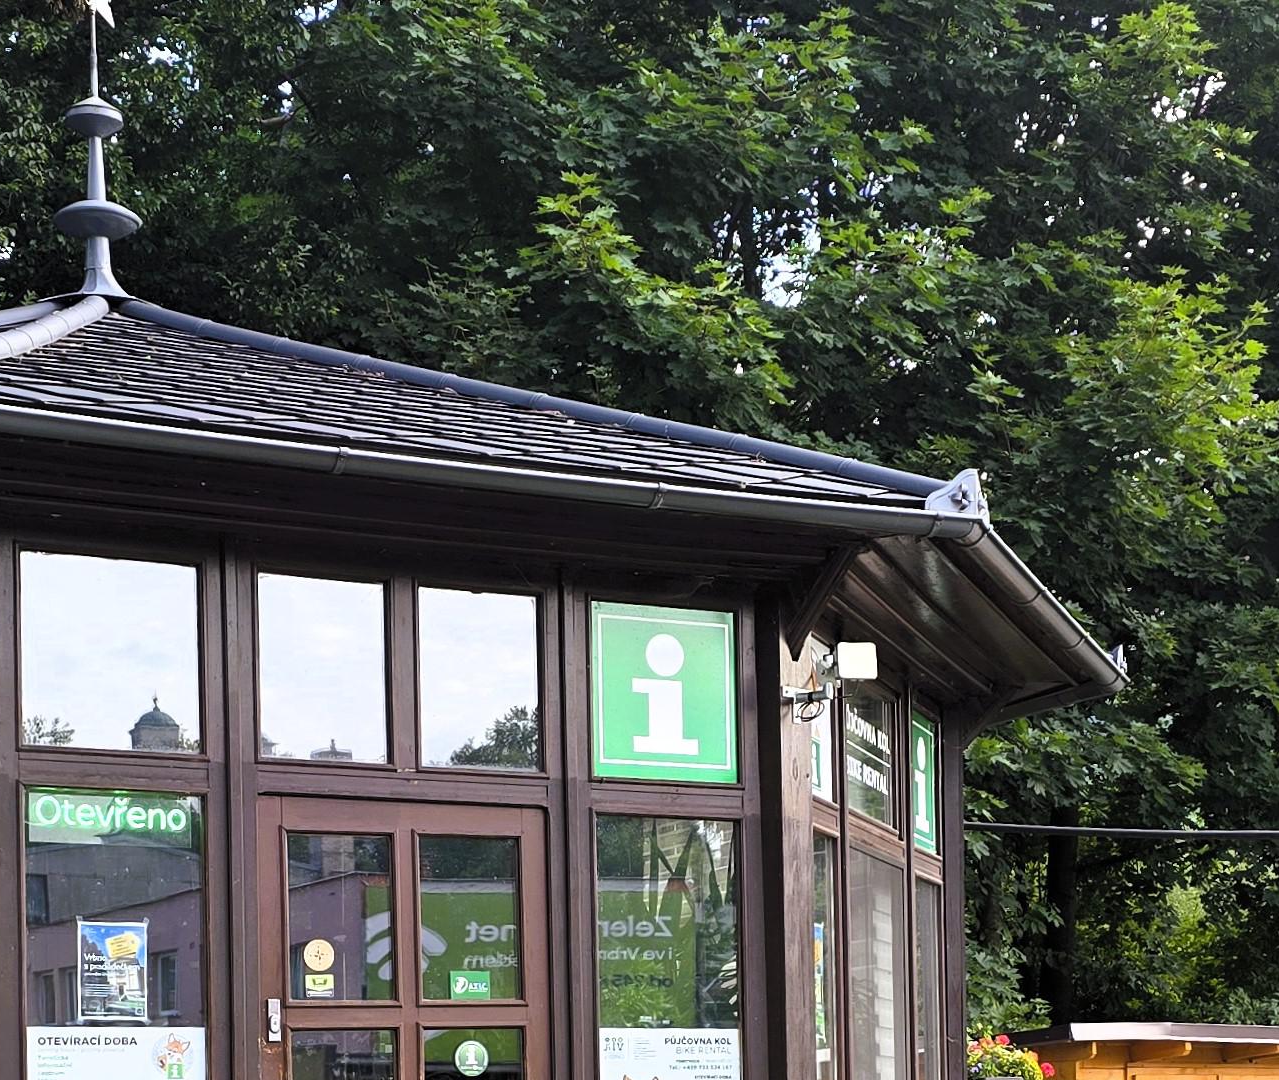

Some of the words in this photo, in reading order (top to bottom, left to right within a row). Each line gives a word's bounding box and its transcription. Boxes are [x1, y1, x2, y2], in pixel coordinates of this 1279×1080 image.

[845, 703, 877, 747] ŮJČOVNA
[877, 728, 891, 755] KOL
[863, 763, 889, 796] RENTAL
[35, 794, 187, 831] Otevřeno
[37, 1034, 101, 1046] OTEVÍRACÍ
[104, 1036, 138, 1046] DOBA
[664, 1034, 712, 1045] PŮJČOVNA
[714, 1037, 732, 1045] KOL
[675, 1046, 696, 1054] BIKE
[697, 1046, 732, 1054] RENTAL
